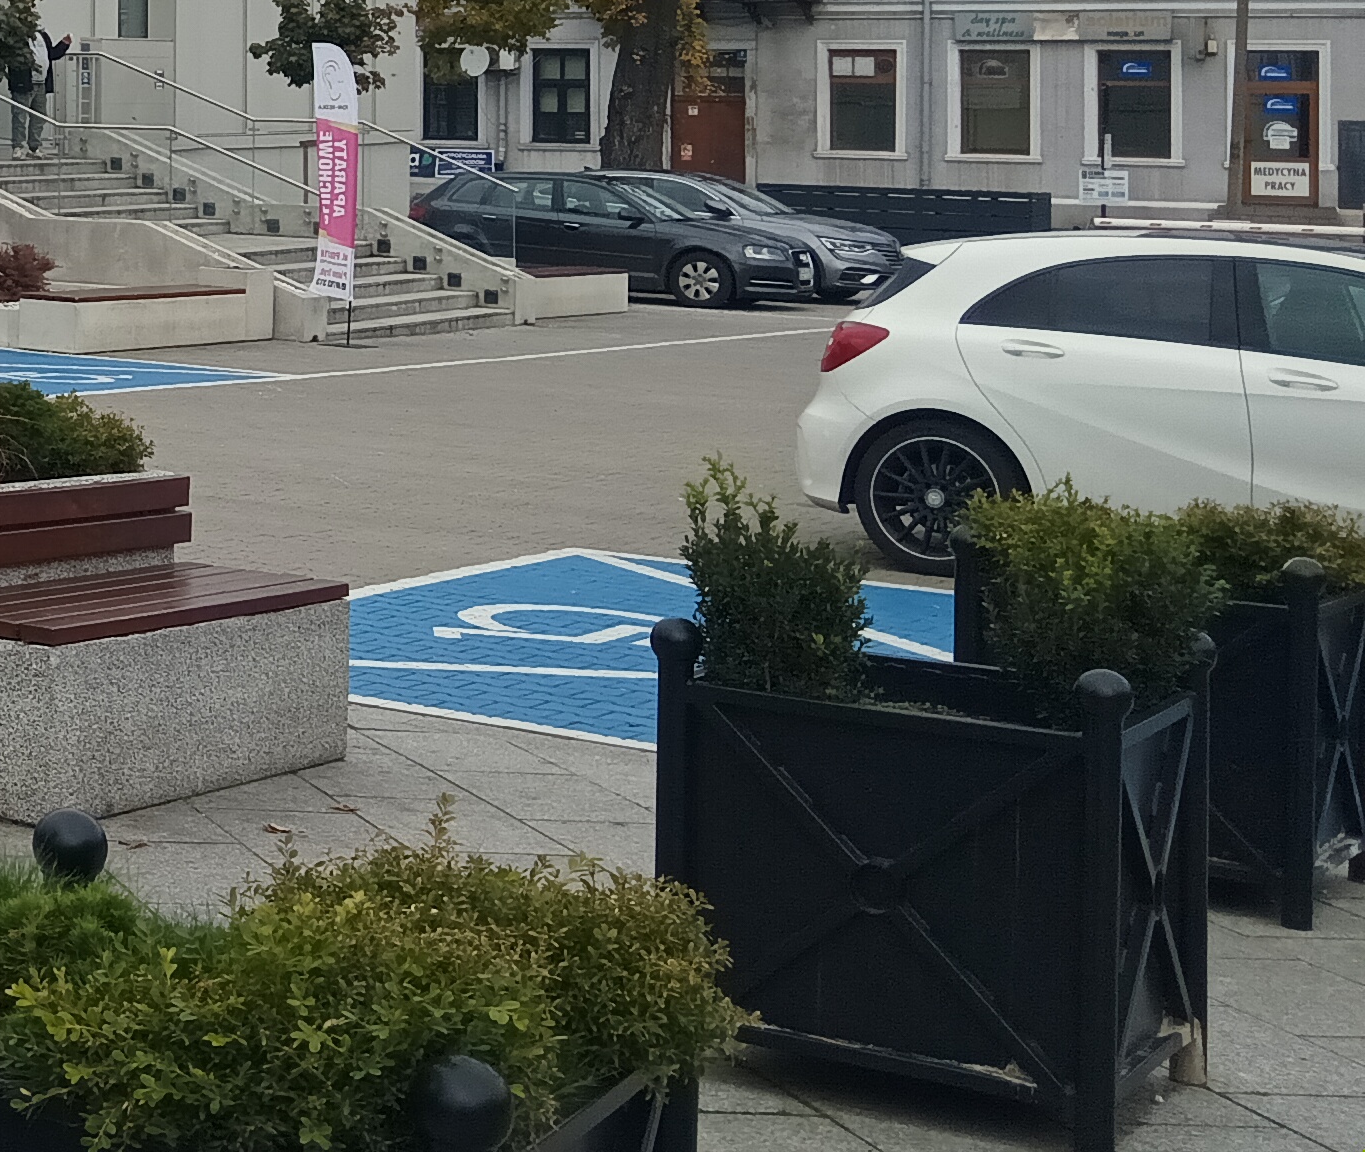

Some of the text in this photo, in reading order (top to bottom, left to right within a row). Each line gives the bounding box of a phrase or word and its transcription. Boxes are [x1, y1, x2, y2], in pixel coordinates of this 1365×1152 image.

[970, 14, 1016, 28] day spa
[976, 27, 1025, 38] wellness
[1254, 166, 1307, 177] MEDYCYNA
[1264, 181, 1296, 191] PRACY
